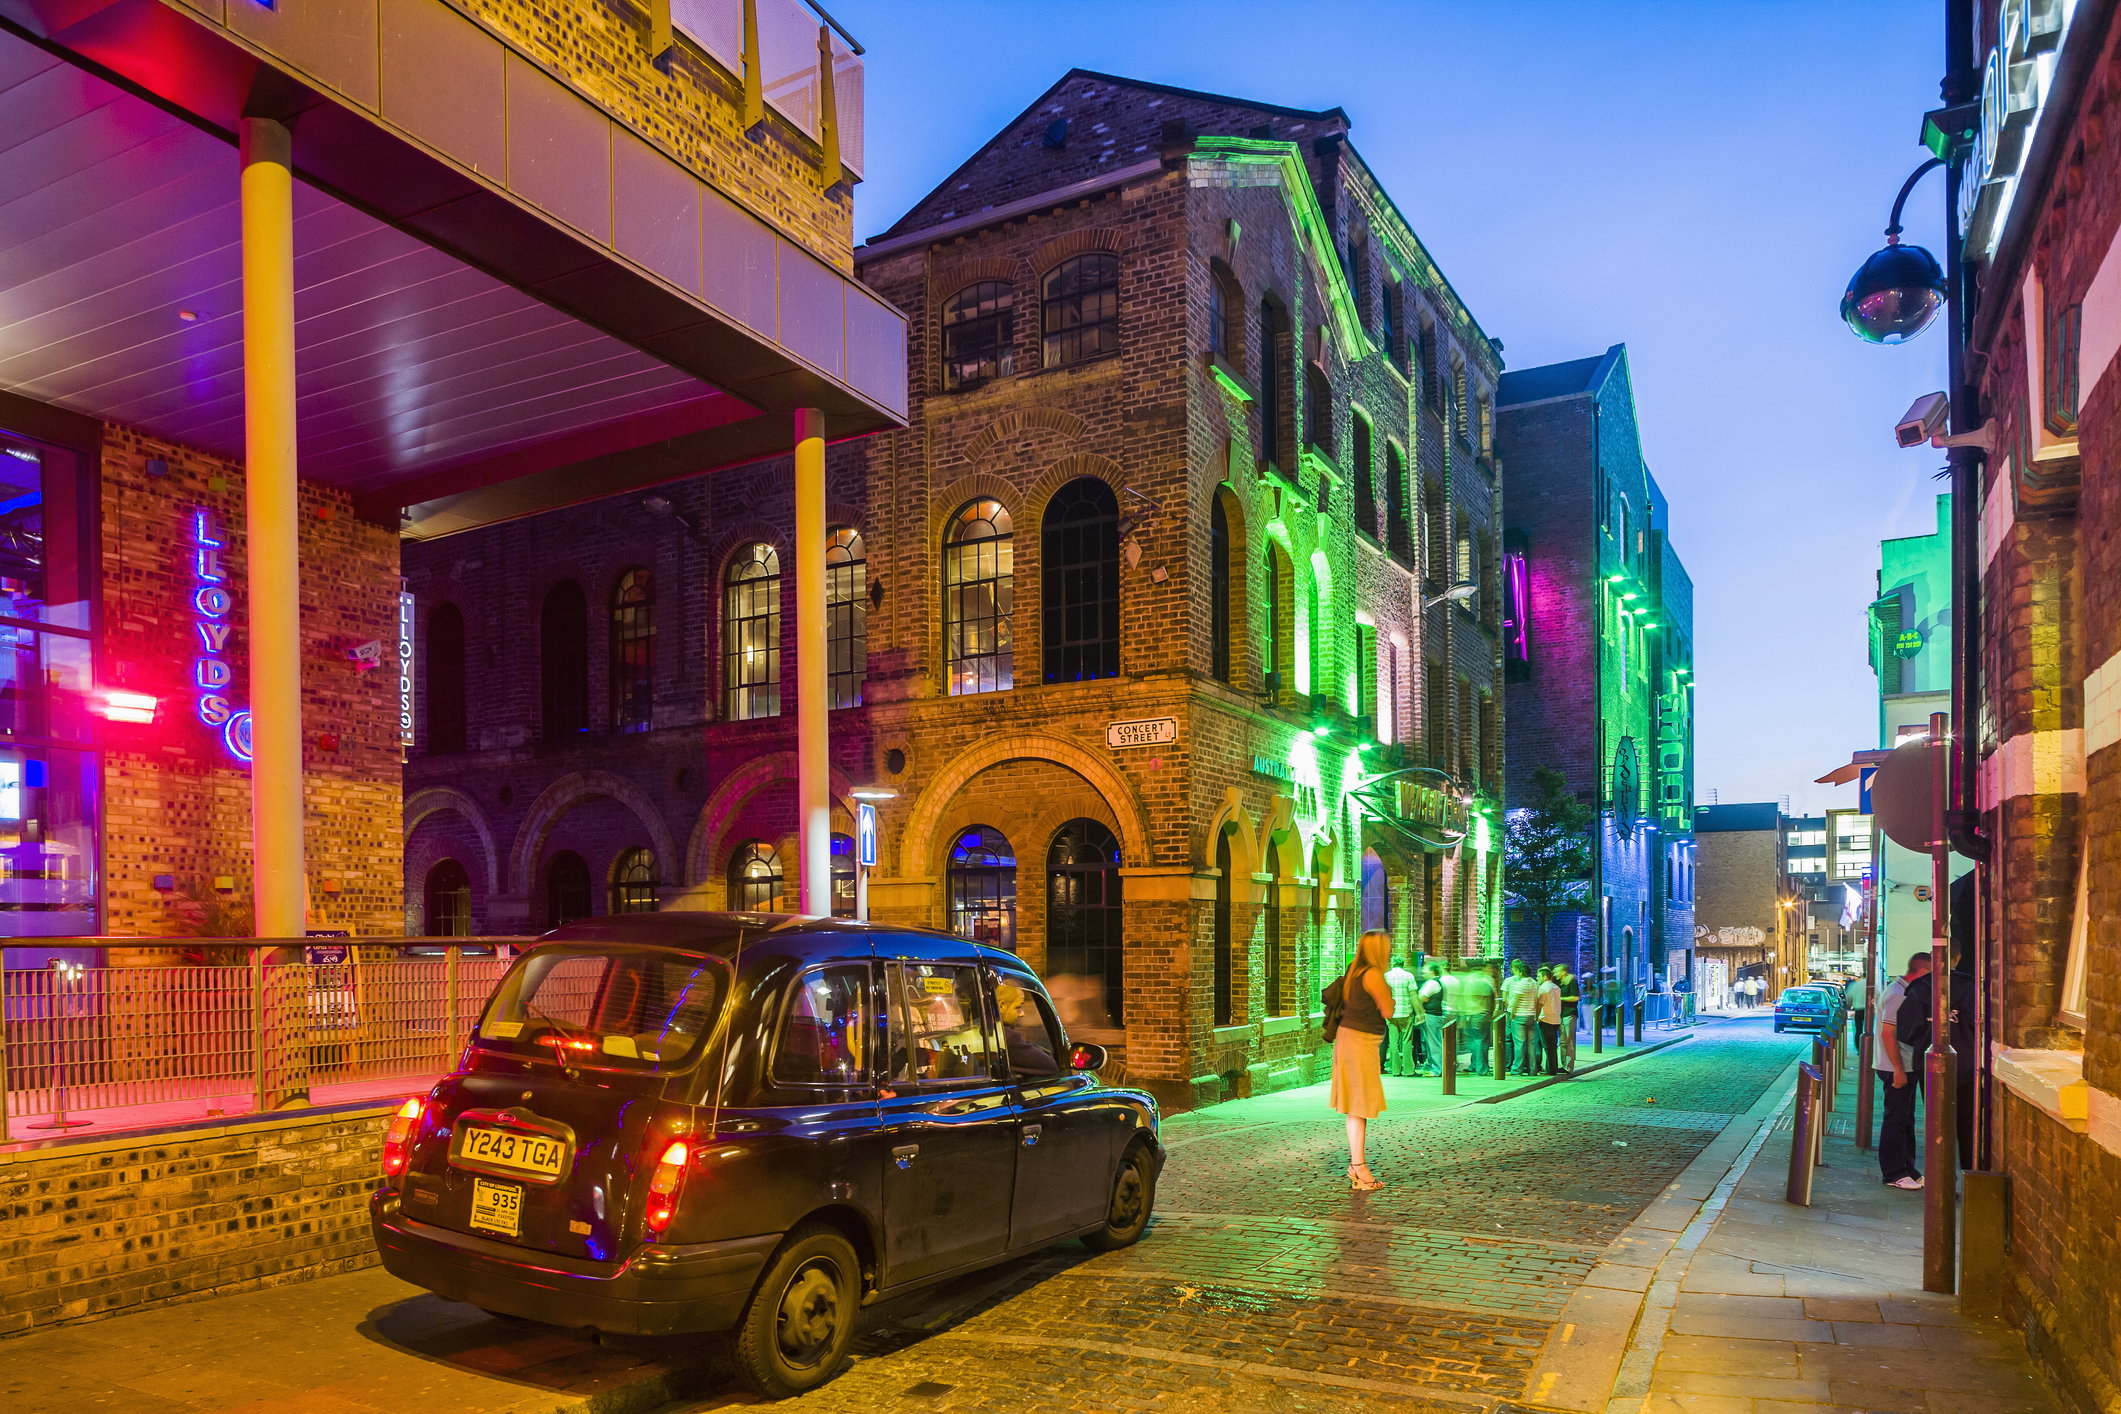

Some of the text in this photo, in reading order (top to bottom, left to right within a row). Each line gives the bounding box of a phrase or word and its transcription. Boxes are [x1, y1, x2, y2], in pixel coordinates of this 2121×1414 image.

[197, 512, 231, 724] LLOYDS
[400, 605, 412, 711] LLOYDS
[1117, 722, 1165, 735] CONCERT
[1120, 732, 1159, 744] STREET
[468, 1130, 559, 1168] Y243 TGA
[492, 1192, 517, 1209] 935
